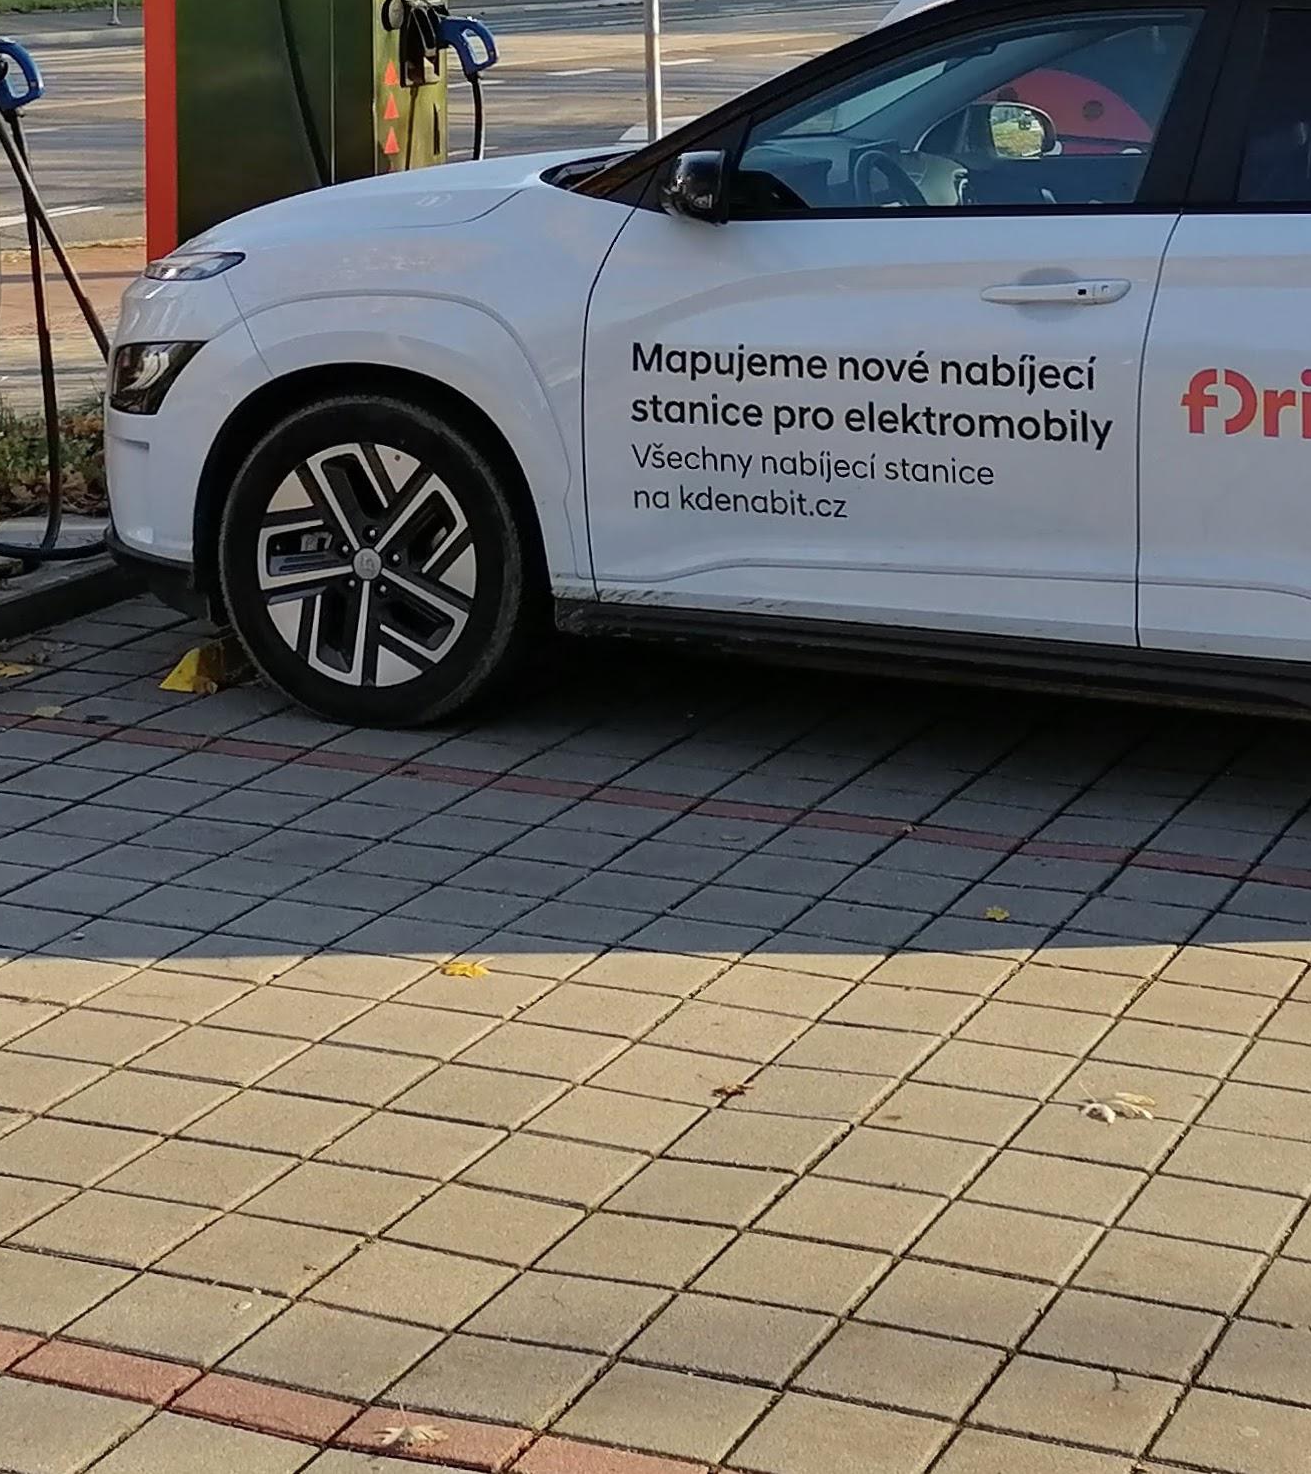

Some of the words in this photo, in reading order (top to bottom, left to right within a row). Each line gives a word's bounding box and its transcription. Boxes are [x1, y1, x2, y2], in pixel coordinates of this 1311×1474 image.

[632, 342, 828, 382] Mapujeme
[838, 350, 930, 383] nové
[940, 353, 1097, 396] nabíjecí
[630, 393, 763, 427] stanice
[773, 404, 835, 435] pro
[844, 401, 1114, 450] elektromobily
[631, 443, 753, 478] Všechny
[761, 450, 877, 483] nabíjecí
[884, 457, 995, 486] stanice
[633, 489, 670, 509] na
[679, 484, 849, 518] kdenabit.cz
